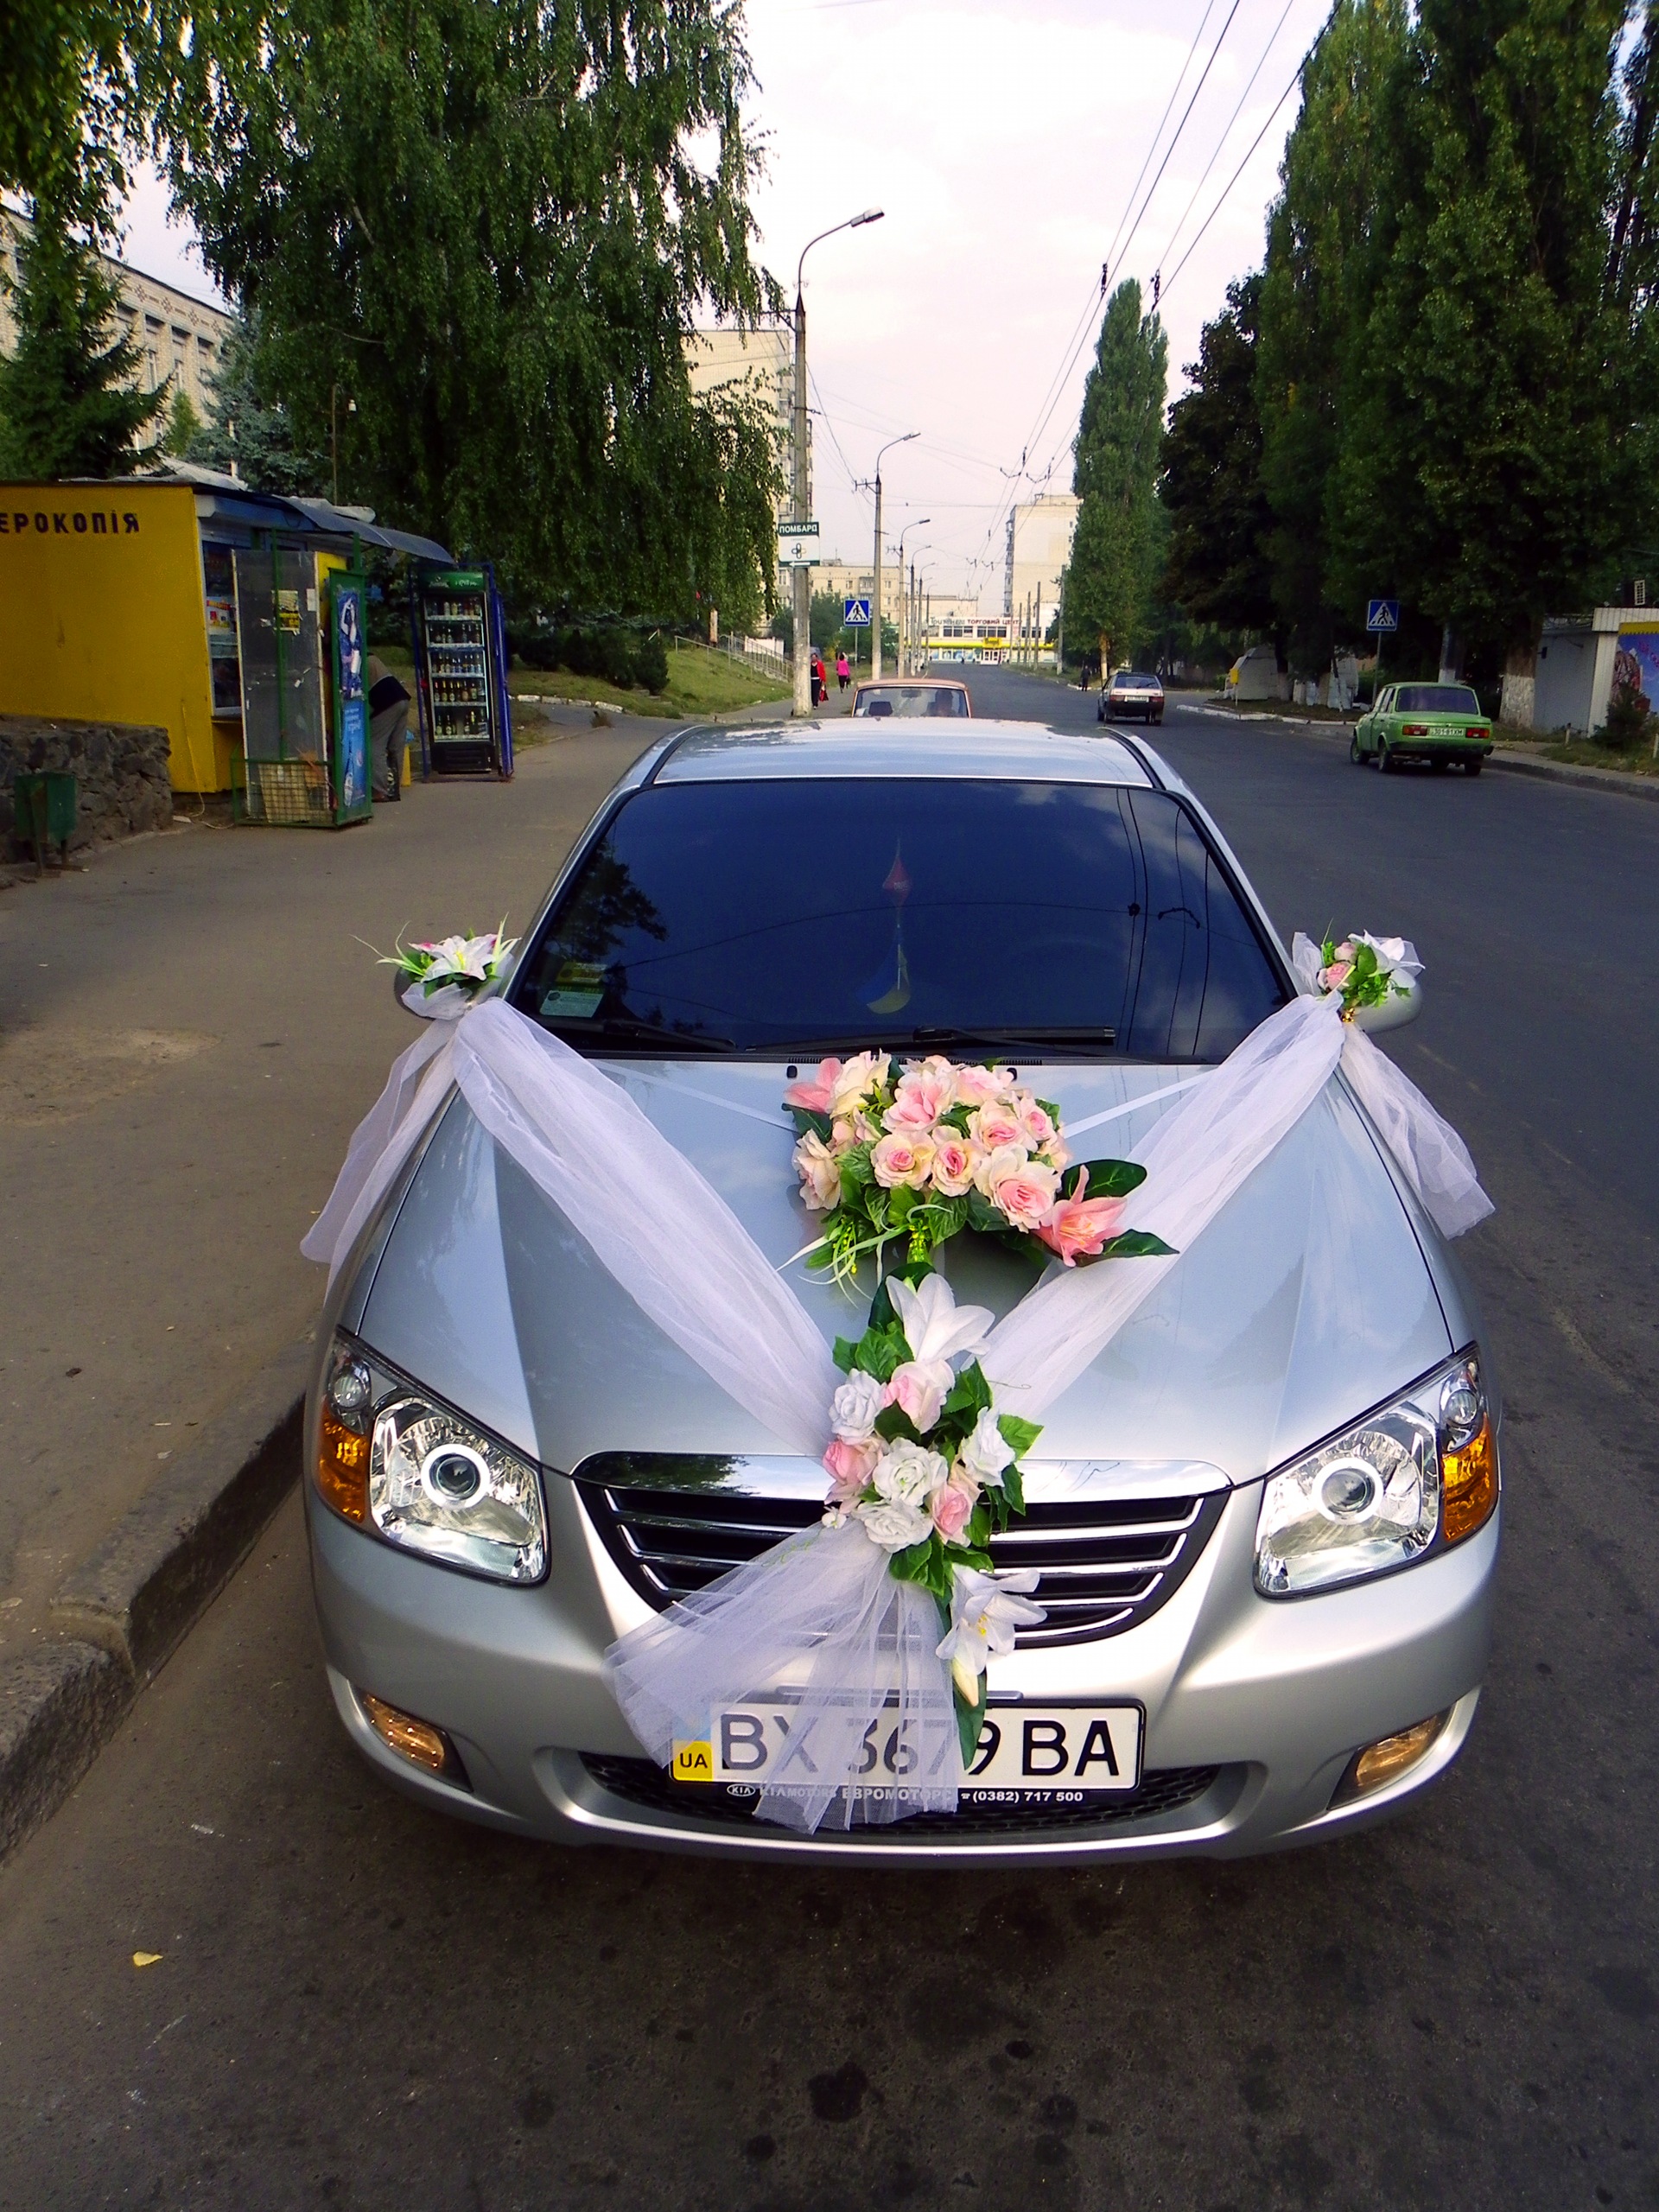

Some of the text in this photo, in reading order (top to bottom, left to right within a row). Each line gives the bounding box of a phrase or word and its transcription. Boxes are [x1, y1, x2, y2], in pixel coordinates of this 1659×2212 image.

[679, 1752, 709, 1769] UA
[730, 1785, 753, 1796] KIA
[972, 1790, 1020, 1803] (0382)
[1024, 1791, 1052, 1802] 717
[1055, 1791, 1084, 1802] 500
